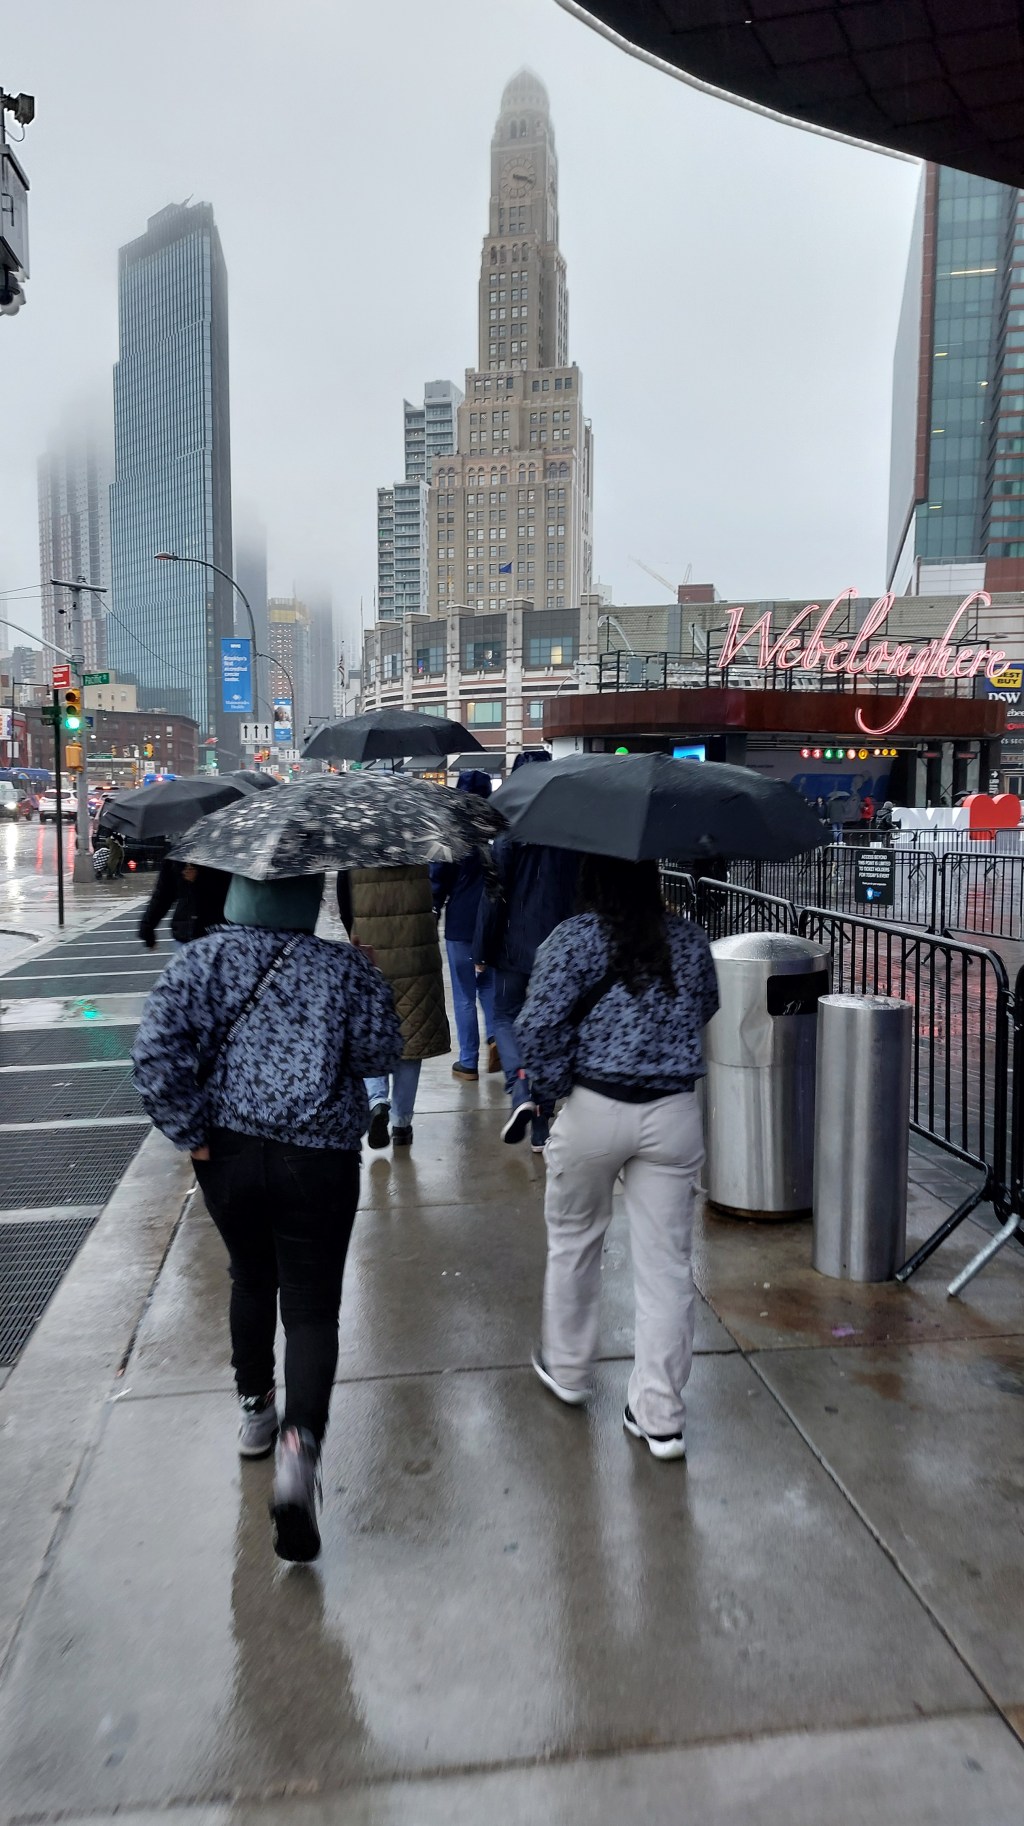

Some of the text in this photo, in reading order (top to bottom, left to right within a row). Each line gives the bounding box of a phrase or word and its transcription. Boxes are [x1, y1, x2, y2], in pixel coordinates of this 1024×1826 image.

[85, 675, 102, 685] Pacific
[988, 692, 1021, 703] DSW
[254, 968, 277, 999] adidas
[227, 1013, 248, 1042] adidas
